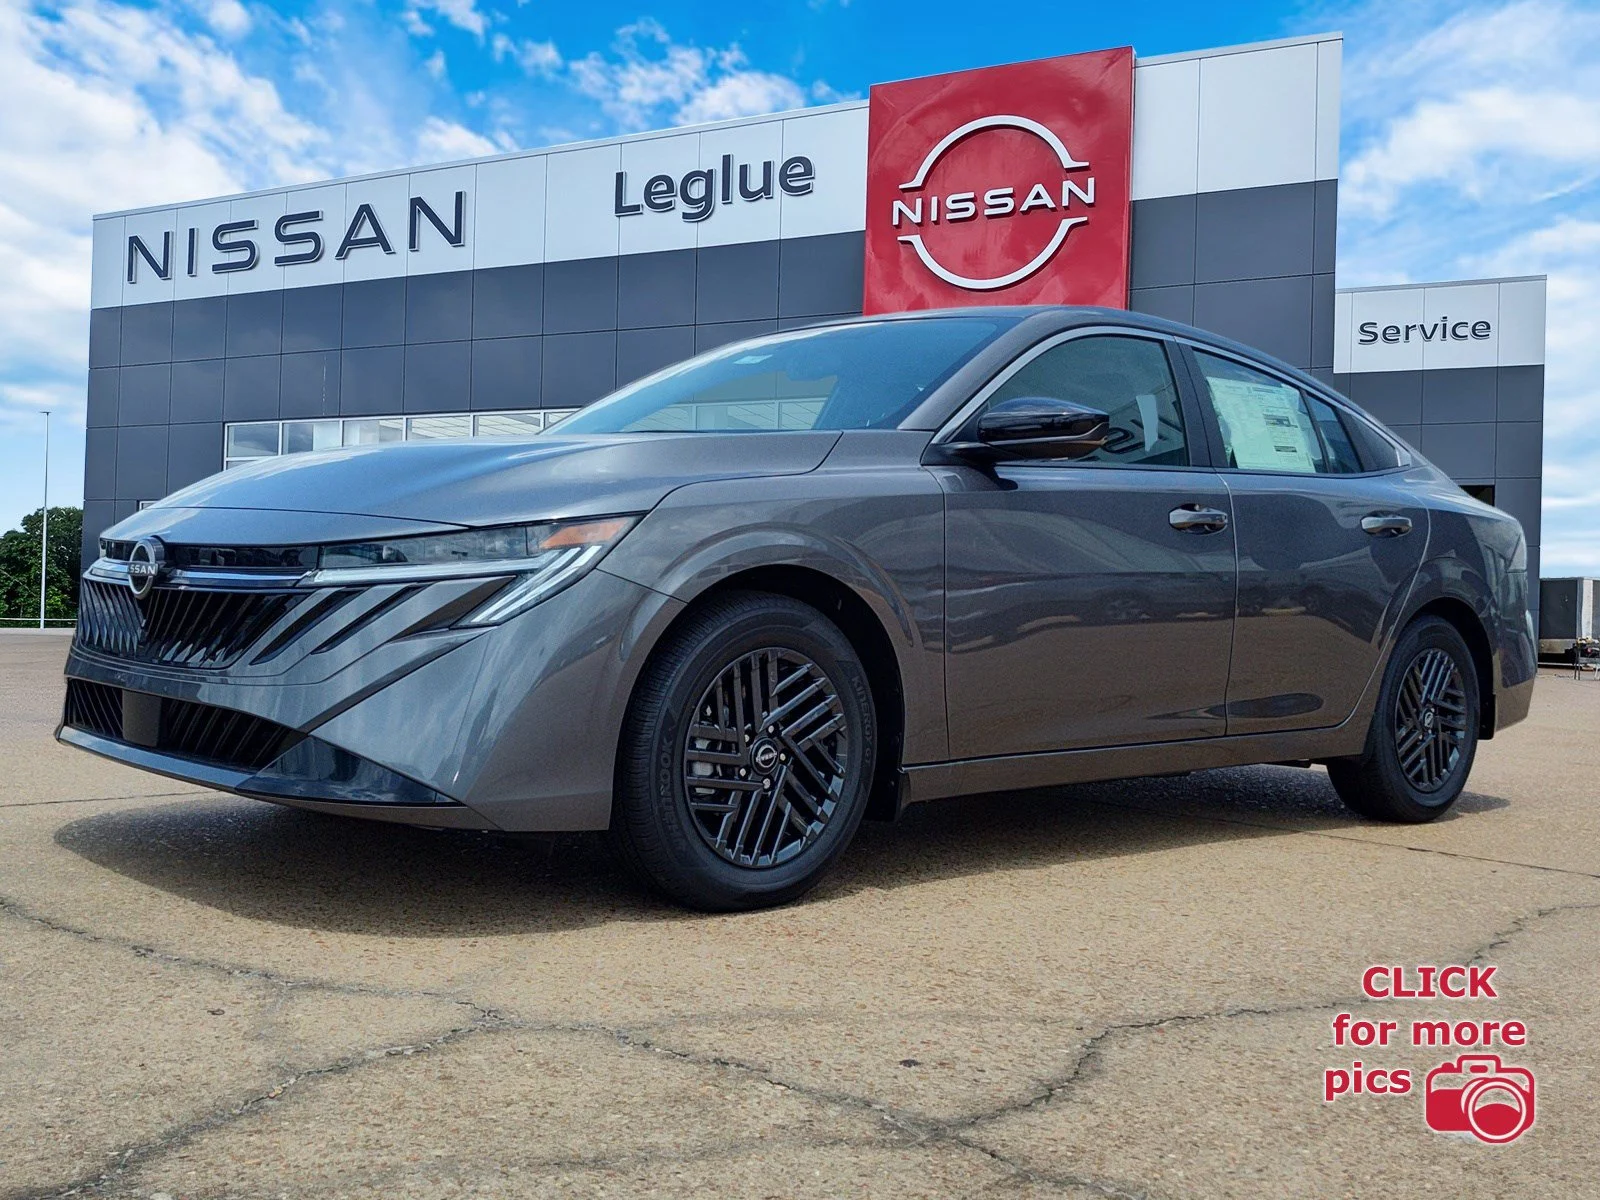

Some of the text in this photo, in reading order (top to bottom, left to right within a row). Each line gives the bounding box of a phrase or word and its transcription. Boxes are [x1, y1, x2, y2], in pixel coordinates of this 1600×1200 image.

[614, 153, 815, 222] Leglue
[892, 177, 1095, 226] NISSAN
[127, 190, 467, 284] NISSAN
[1358, 316, 1491, 345] Service
[129, 563, 156, 575] SSAN
